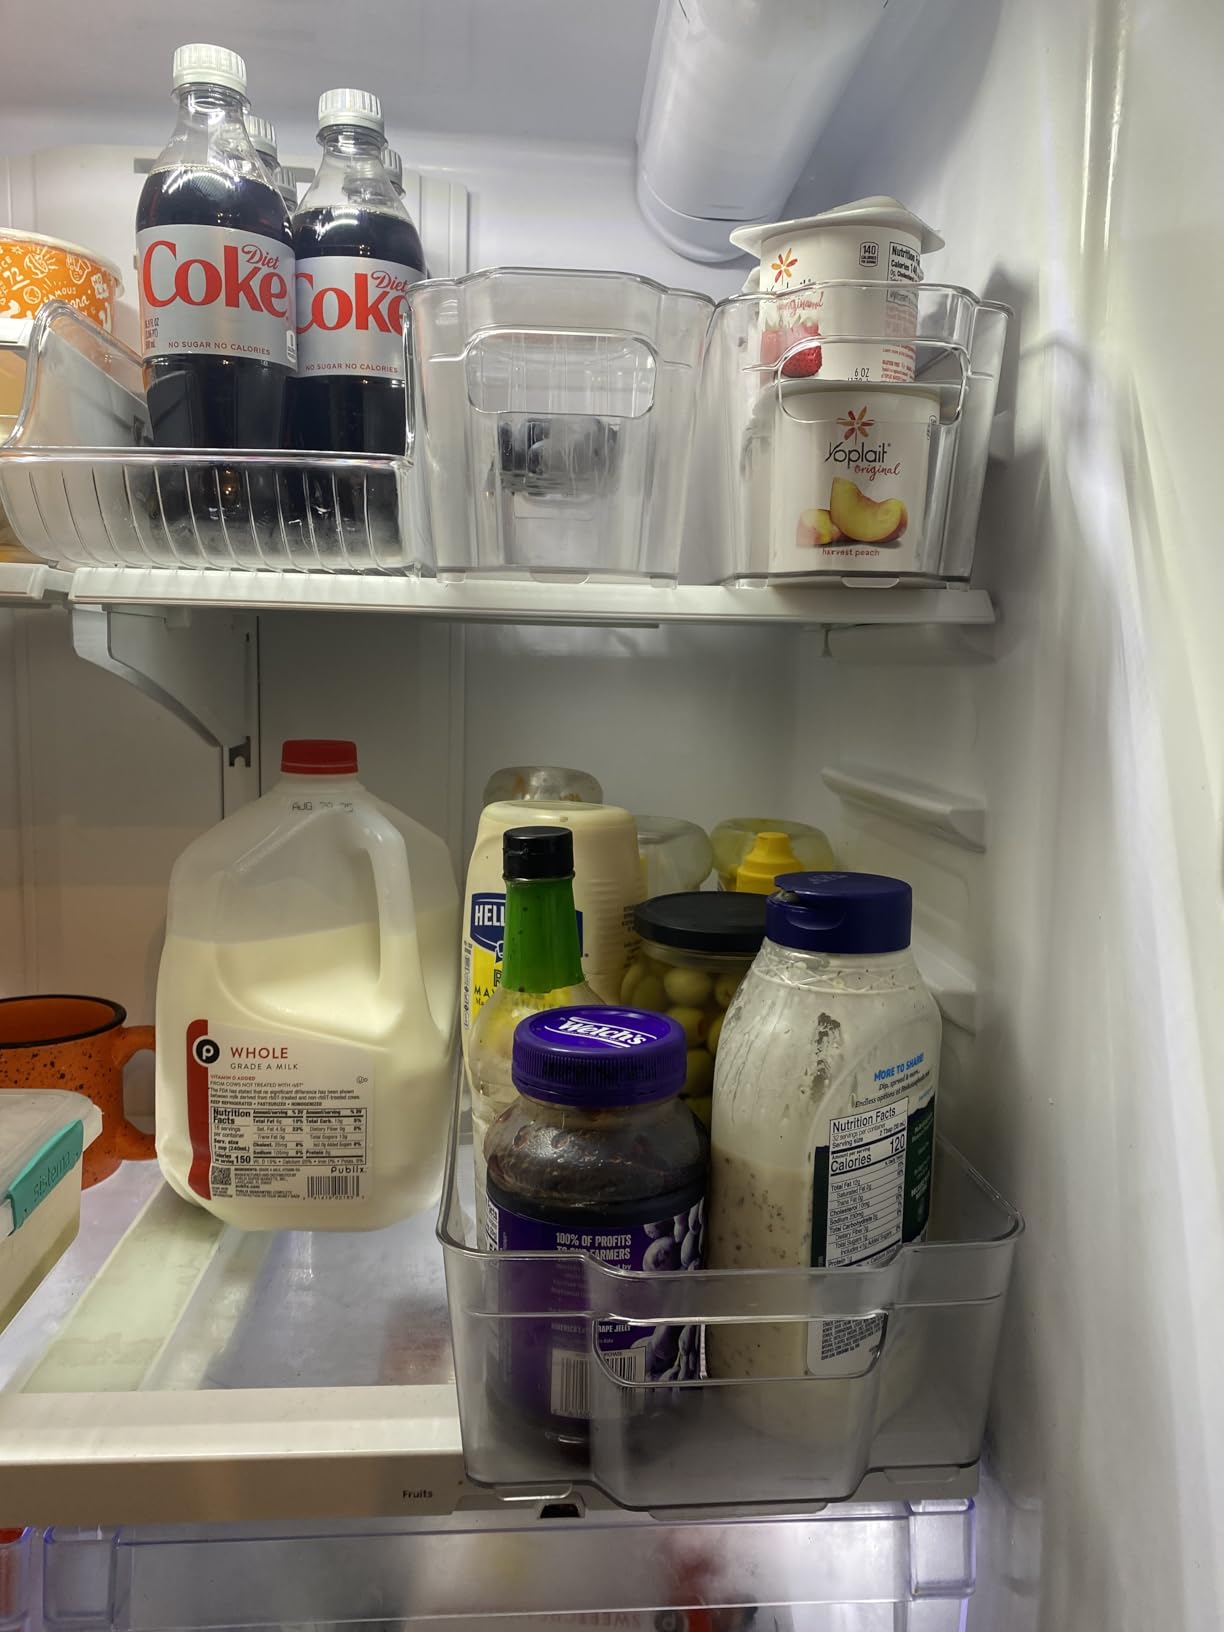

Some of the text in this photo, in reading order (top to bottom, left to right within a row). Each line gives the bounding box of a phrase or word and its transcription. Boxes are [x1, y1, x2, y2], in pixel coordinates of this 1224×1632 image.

[863, 245, 876, 255] 140
[892, 246, 916, 262] Nutrition
[241, 244, 280, 269] Diet
[891, 260, 910, 271] Calories
[143, 240, 287, 318] Coke
[371, 270, 410, 292] Diet
[214, 342, 227, 350] NO
[230, 344, 270, 356] CALORIES
[360, 364, 398, 374] CALORIES
[855, 368, 869, 377] 6 OZ
[824, 442, 888, 469] Yoplait
[854, 549, 880, 557] peach
[292, 801, 313, 811] AUG
[558, 1020, 647, 1045] Welch's
[230, 1047, 288, 1059] WHOLE
[874, 1067, 895, 1082] MORE
[897, 1064, 905, 1073] TO
[906, 1052, 924, 1070] SHARE
[855, 1098, 876, 1108] Endless
[213, 1109, 251, 1117] Nutrition
[832, 1106, 896, 1133] Nutrition Facts
[867, 1123, 885, 1133] container
[832, 1141, 852, 1149] Serving
[890, 1134, 905, 1154] 120
[235, 1155, 251, 1163] 150
[831, 1154, 871, 1172] Calories
[837, 1188, 858, 1198] Saturated
[830, 1205, 857, 1216] Cholesterol
[830, 1216, 848, 1225] Sodium
[842, 1216, 872, 1230] Carbohydrate
[556, 1232, 632, 1247] 100% OF PROFITS
[590, 1248, 630, 1260] FARMERS
[402, 1489, 432, 1498] Fruits
